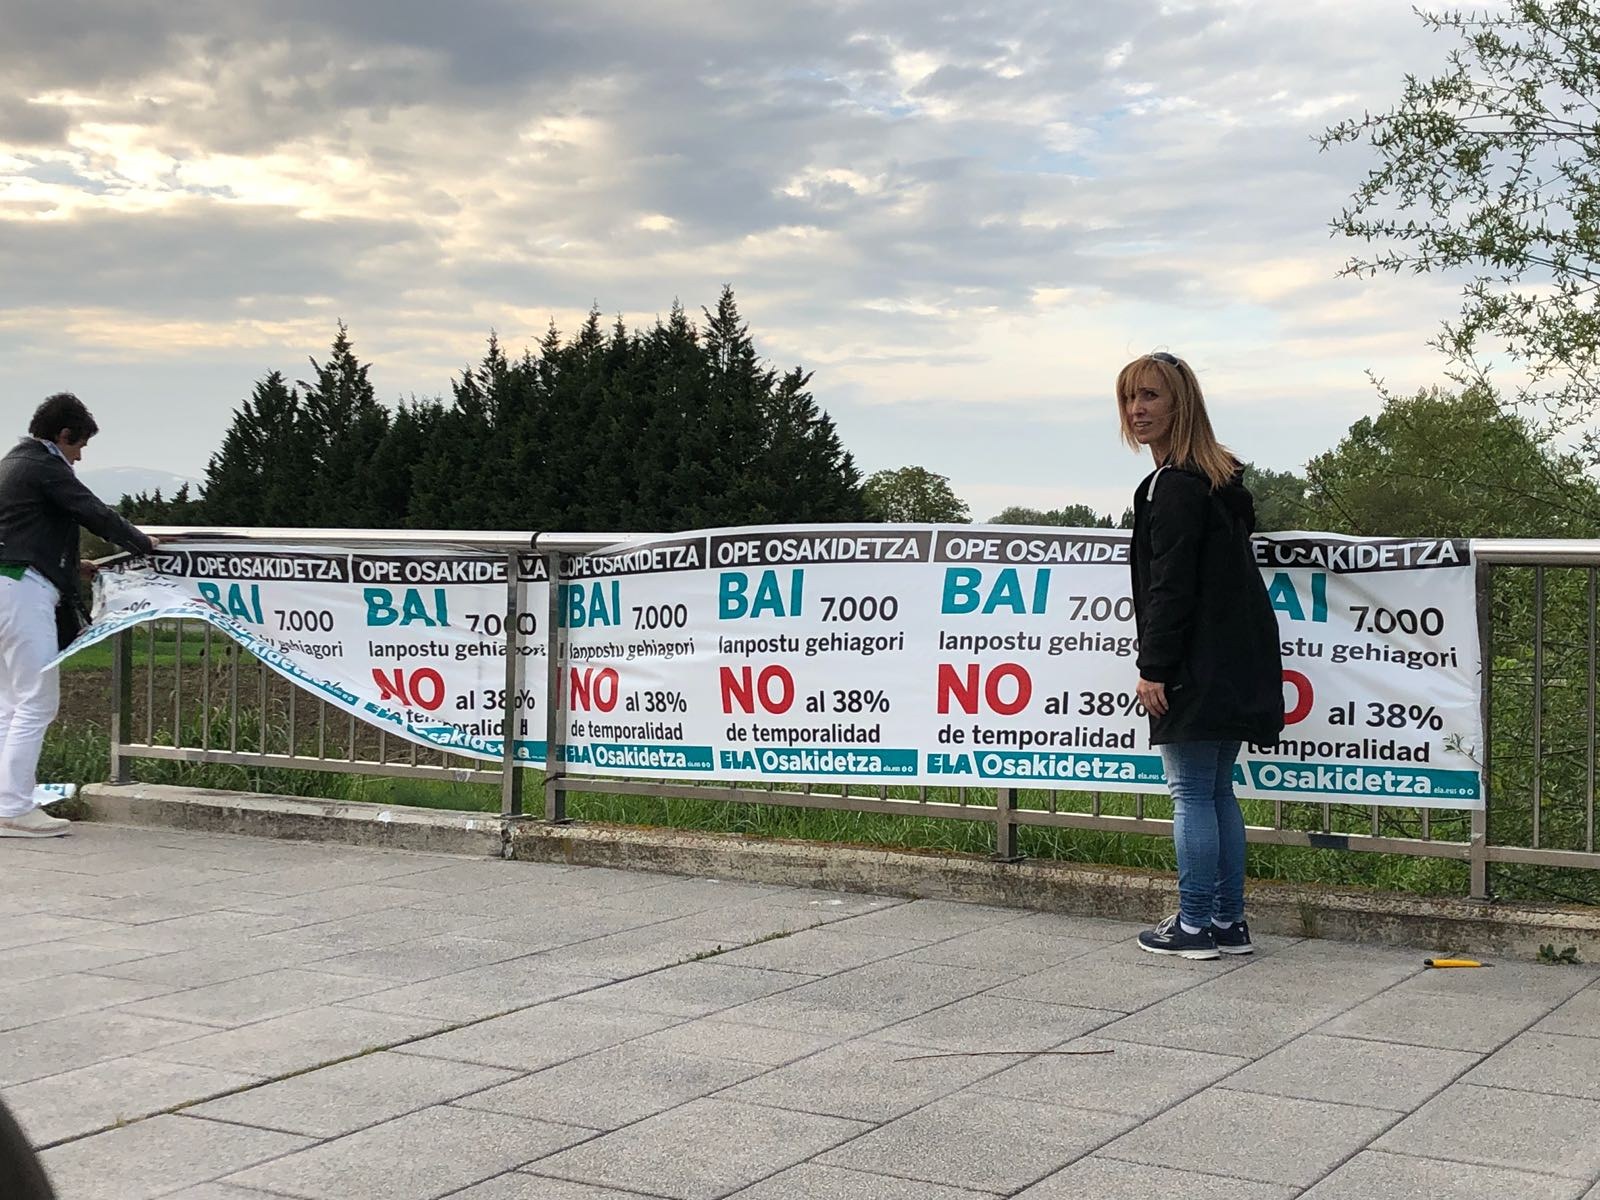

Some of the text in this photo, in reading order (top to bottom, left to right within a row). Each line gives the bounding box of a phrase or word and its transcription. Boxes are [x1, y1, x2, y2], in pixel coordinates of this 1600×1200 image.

[593, 545, 700, 574] OSAKIDETZA
[717, 538, 920, 565] OPE OSAKIDETZA
[945, 537, 1002, 561] OPE
[197, 557, 228, 577] OPE
[229, 557, 342, 580] OSAKIDETZA
[359, 561, 402, 582] OPE
[718, 569, 898, 622] BAI 7.000
[941, 567, 1051, 614] BAI
[197, 582, 265, 625] BAI
[273, 610, 334, 633] 7.000
[363, 588, 452, 627] BAI
[566, 580, 688, 630] BAI 7.000
[1350, 606, 1444, 636] 7.000
[368, 640, 449, 661] lanpostu
[569, 638, 695, 662] lanpostu gehiagori
[719, 632, 904, 657] lanpostu gehiagori
[939, 631, 1041, 655] lanpostu
[1330, 643, 1458, 670] gehiagori
[371, 667, 445, 711] NO
[456, 691, 474, 710] al
[570, 667, 687, 713] NO al 38%
[719, 665, 890, 714] NO al 38%
[937, 663, 1146, 717] NO al 38%
[1328, 701, 1355, 725] al
[1365, 702, 1444, 731] 38%
[571, 720, 683, 743] de temporalidad
[726, 722, 881, 746] de temporalidad
[938, 724, 1136, 750] de temporalidad
[595, 745, 687, 768] Osakidetza
[720, 750, 882, 773] ELA Osakidetza
[927, 753, 973, 774] ELA
[982, 753, 1136, 780] Osakidetza
[1258, 764, 1431, 794] Osakidetza
